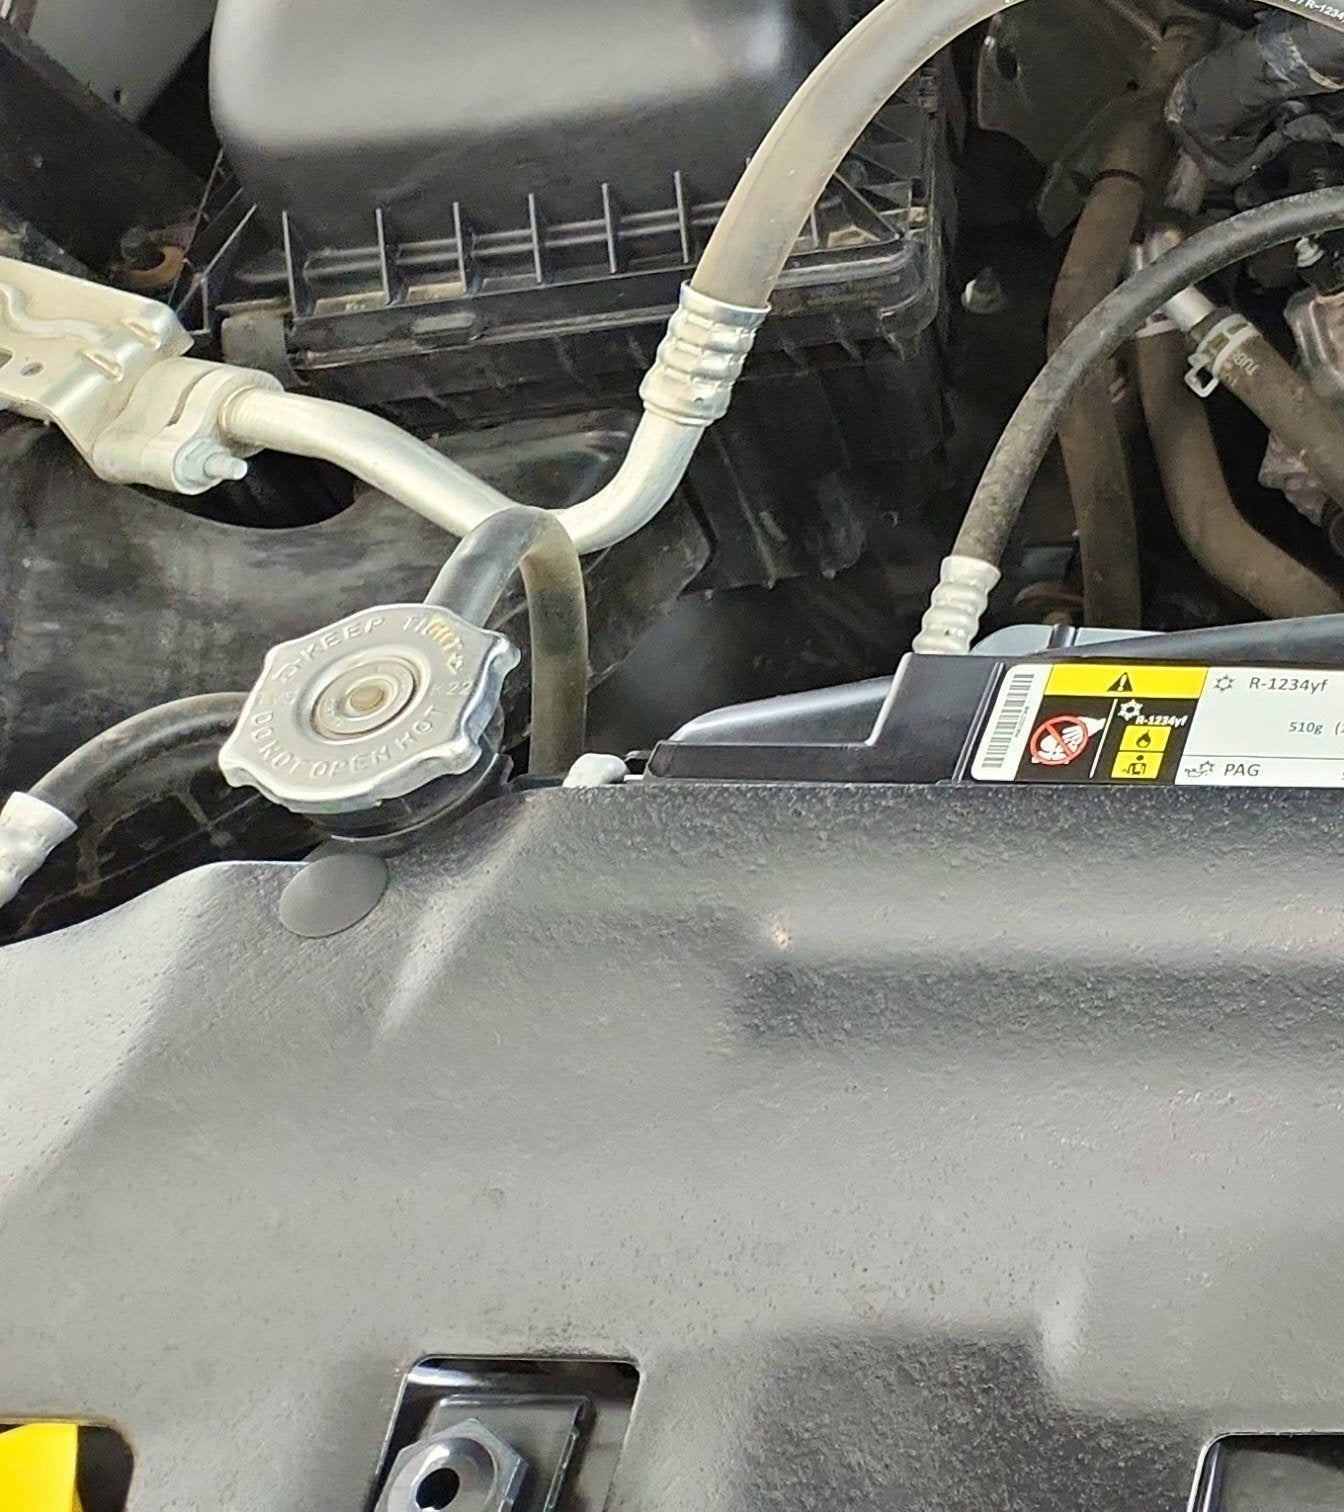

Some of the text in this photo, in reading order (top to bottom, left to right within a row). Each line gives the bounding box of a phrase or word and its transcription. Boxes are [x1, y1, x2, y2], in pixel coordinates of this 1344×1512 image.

[300, 615, 386, 662] KEEP
[1248, 676, 1330, 695] R-1234yf
[1134, 715, 1189, 729] R-1234yf
[1288, 721, 1323, 736] 510g
[250, 703, 443, 780] DO NOT OPEN HOT
[1223, 762, 1261, 778] PAG
